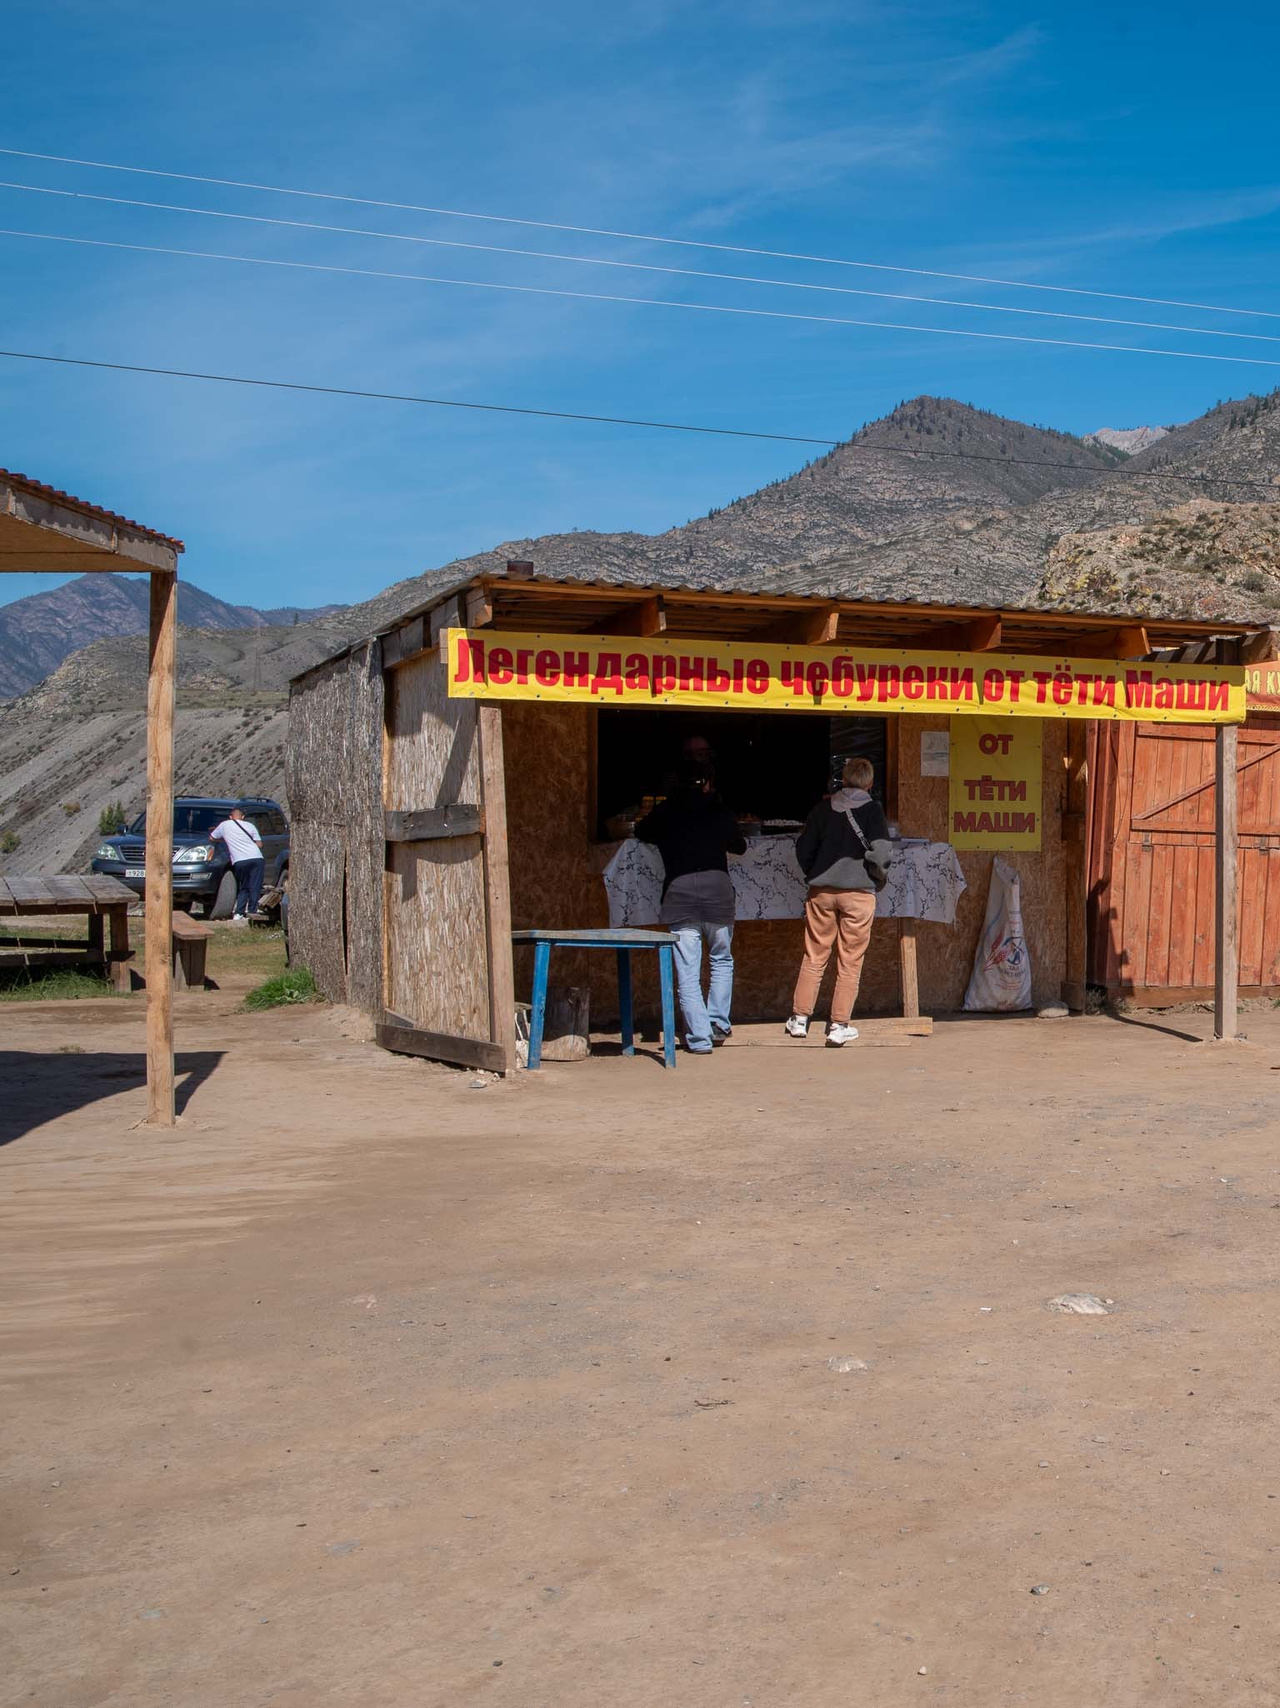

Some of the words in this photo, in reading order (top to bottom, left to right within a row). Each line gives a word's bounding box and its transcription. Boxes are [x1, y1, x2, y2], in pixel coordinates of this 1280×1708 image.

[454, 639, 769, 695] Легендарные
[781, 655, 973, 702] чебуреки
[983, 668, 1024, 703] от
[1032, 664, 1115, 707] тёти
[1125, 669, 1230, 712] Маши
[979, 733, 1013, 755] ОТ
[964, 775, 1026, 801] ТЁТИ
[954, 811, 1035, 833] МАШИ
